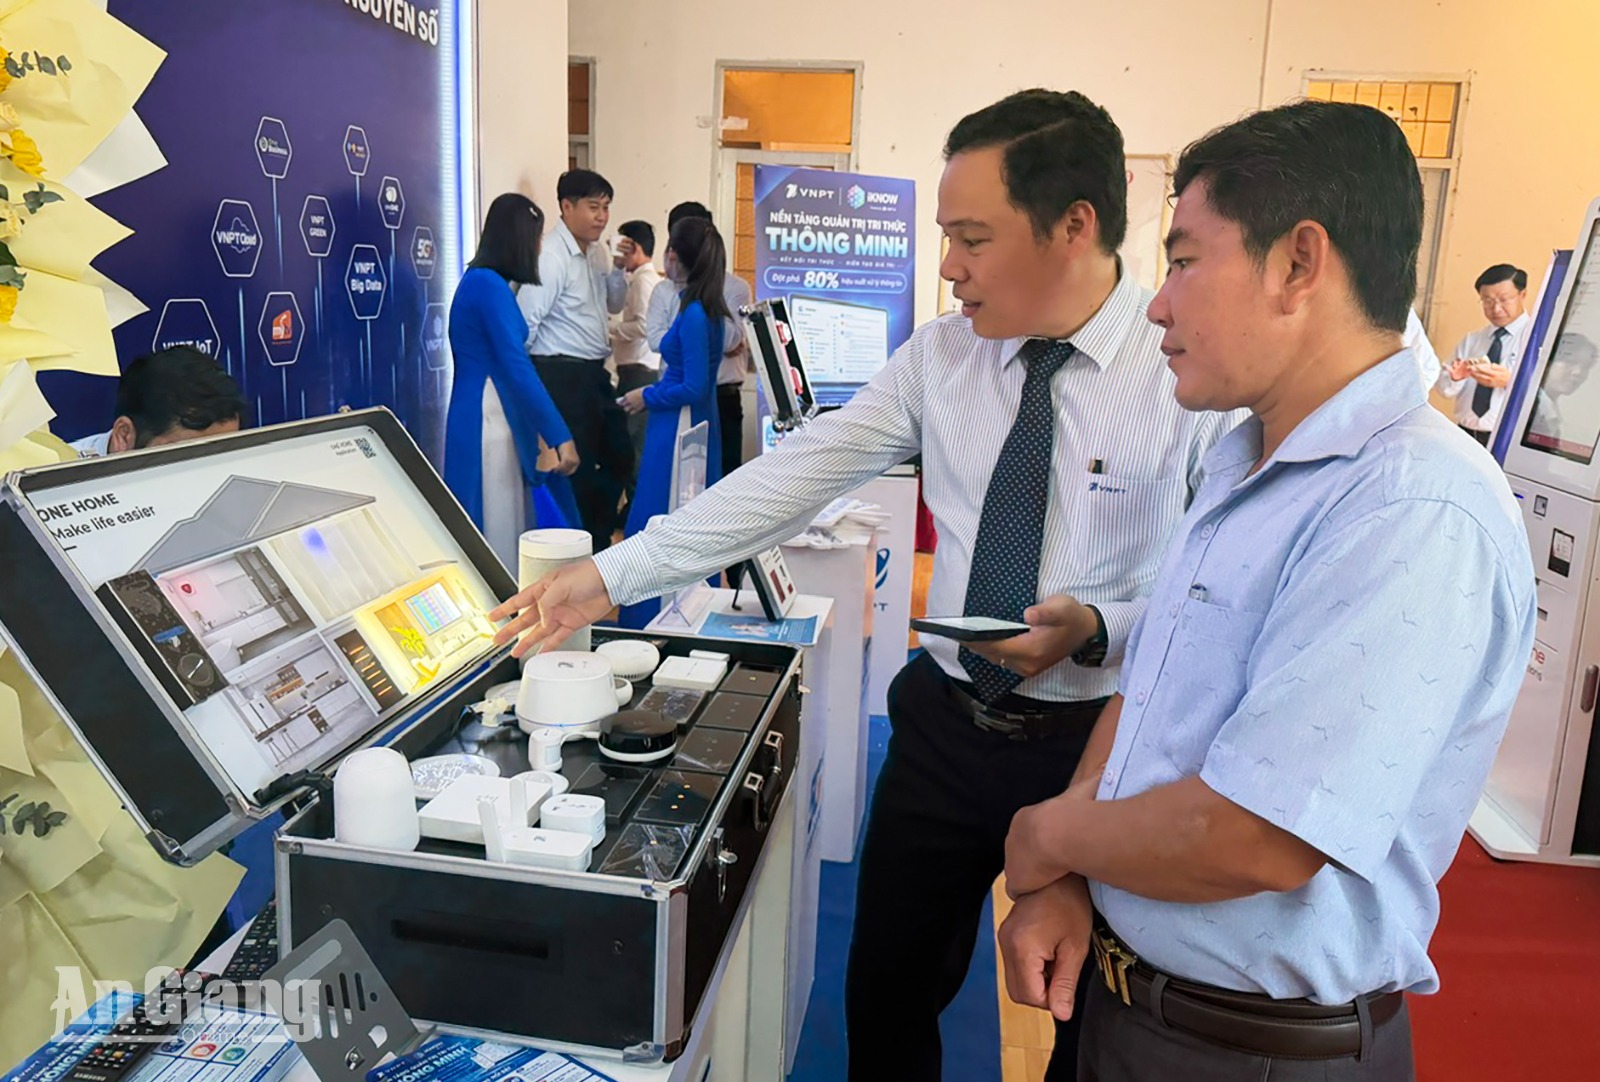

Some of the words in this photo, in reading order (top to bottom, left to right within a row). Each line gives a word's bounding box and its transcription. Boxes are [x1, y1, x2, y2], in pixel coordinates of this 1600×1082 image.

[418, 9, 438, 45] SỐ
[800, 188, 835, 199] VNPT
[765, 225, 850, 254] THÔNG
[854, 233, 909, 258] MINH
[354, 262, 376, 274] VNPT
[350, 278, 365, 294] Big
[365, 279, 382, 291] Data
[803, 270, 839, 289] 80%
[1099, 486, 1127, 495] VNPT
[37, 503, 73, 522] ONE
[72, 493, 120, 513] HOME
[90, 515, 116, 531] life
[117, 505, 156, 524] easier
[432, 1045, 467, 1069] MINH
